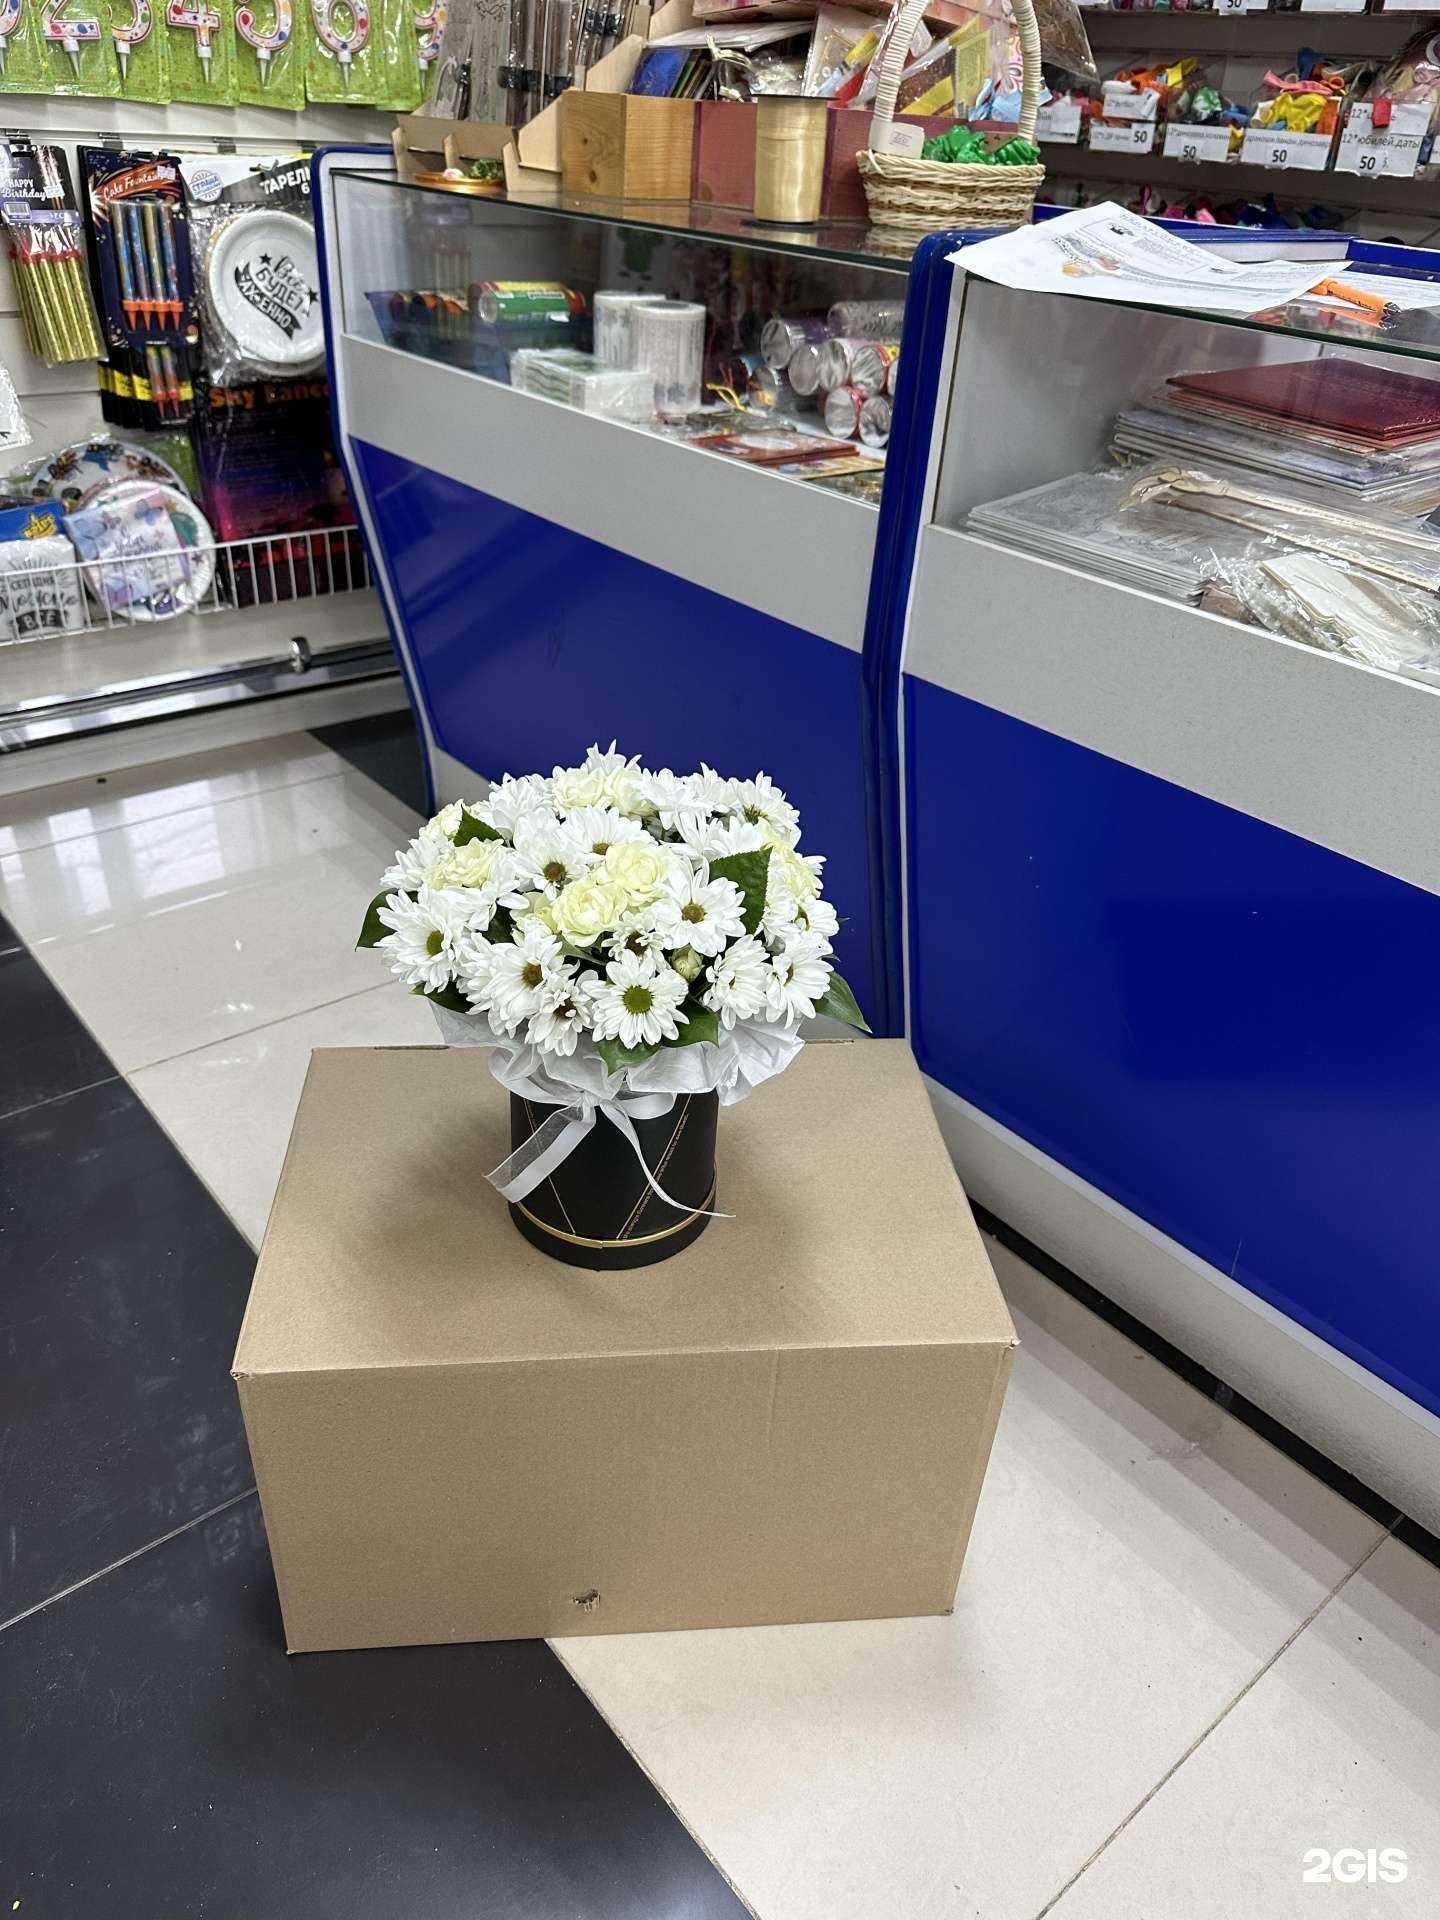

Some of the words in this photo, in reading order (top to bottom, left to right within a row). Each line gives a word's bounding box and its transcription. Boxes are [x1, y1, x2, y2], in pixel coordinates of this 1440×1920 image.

[1133, 130, 1148, 143] 50
[1183, 144, 1198, 159] 50
[1271, 148, 1288, 163] 50
[1359, 155, 1377, 170] 50
[9, 178, 34, 188] HAPPY
[103, 182, 125, 202] Cake
